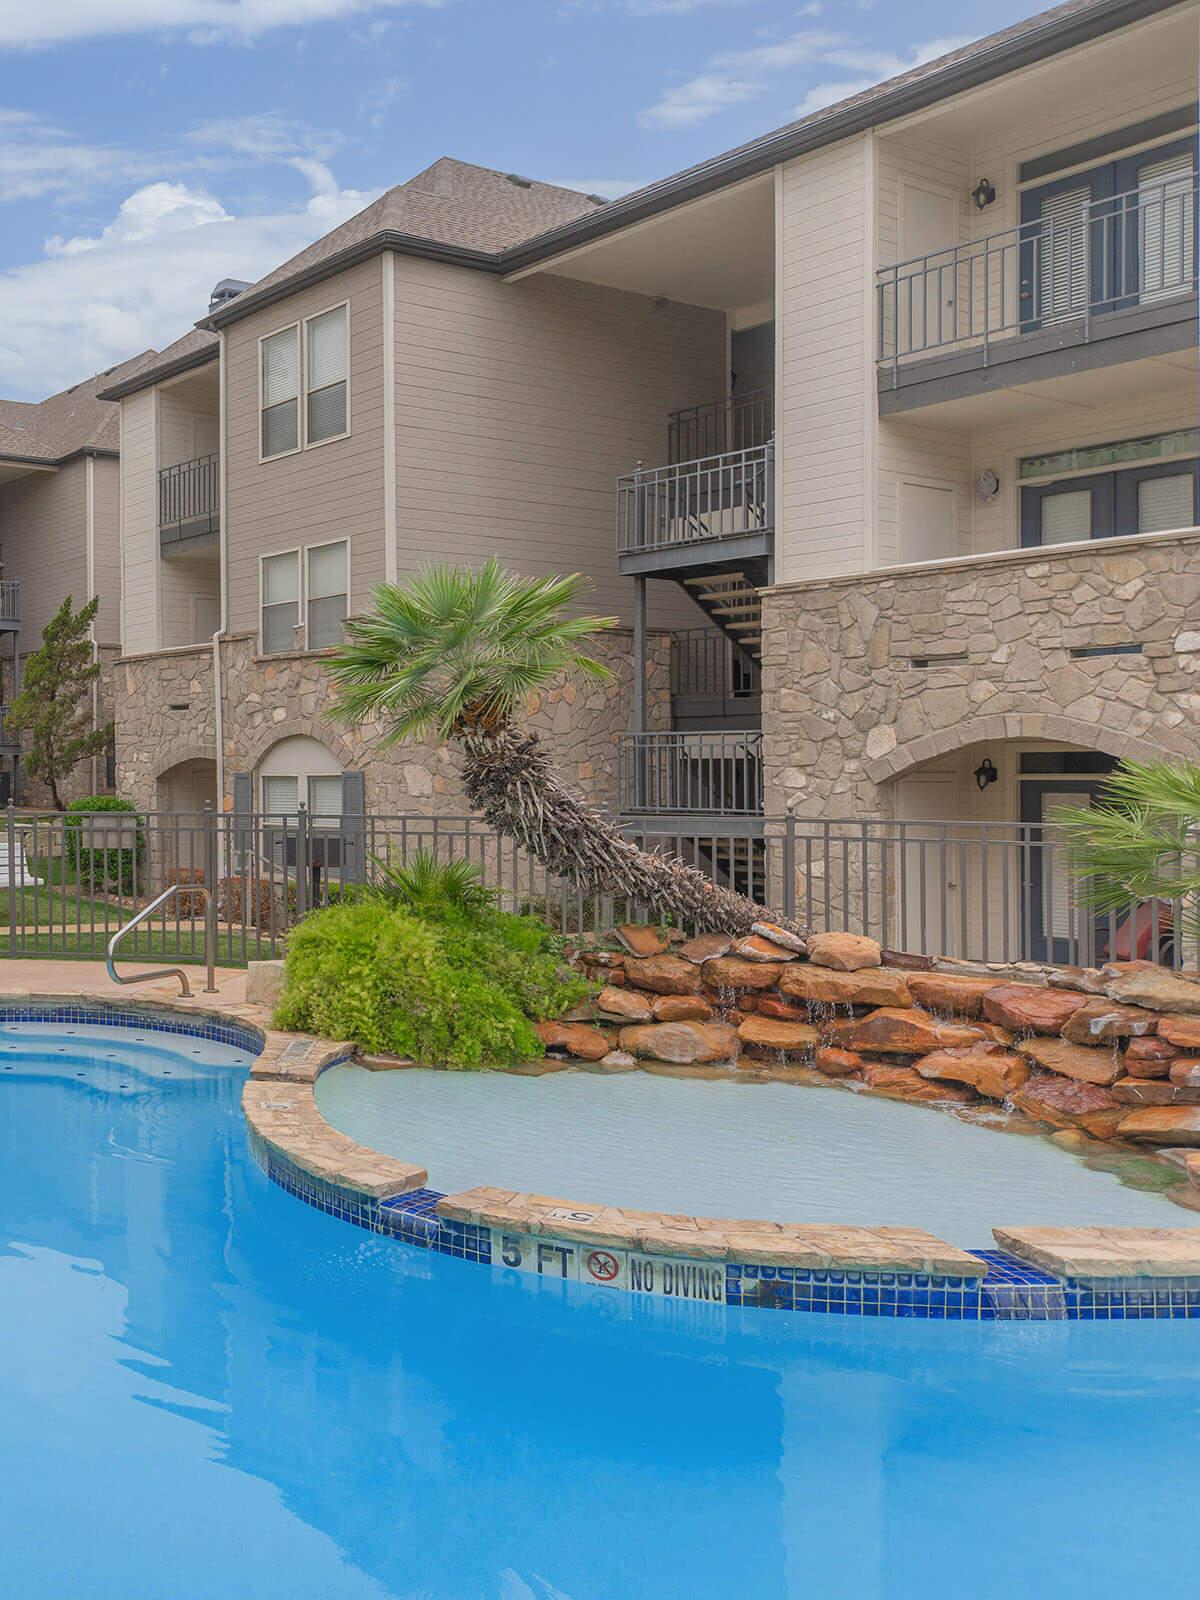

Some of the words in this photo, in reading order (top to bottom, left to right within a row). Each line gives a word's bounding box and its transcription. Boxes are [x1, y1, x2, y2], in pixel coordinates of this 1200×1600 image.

[502, 1234, 522, 1268] 5
[537, 1243, 575, 1279] FT
[630, 1257, 655, 1292] NO
[663, 1264, 722, 1302] DIVING
